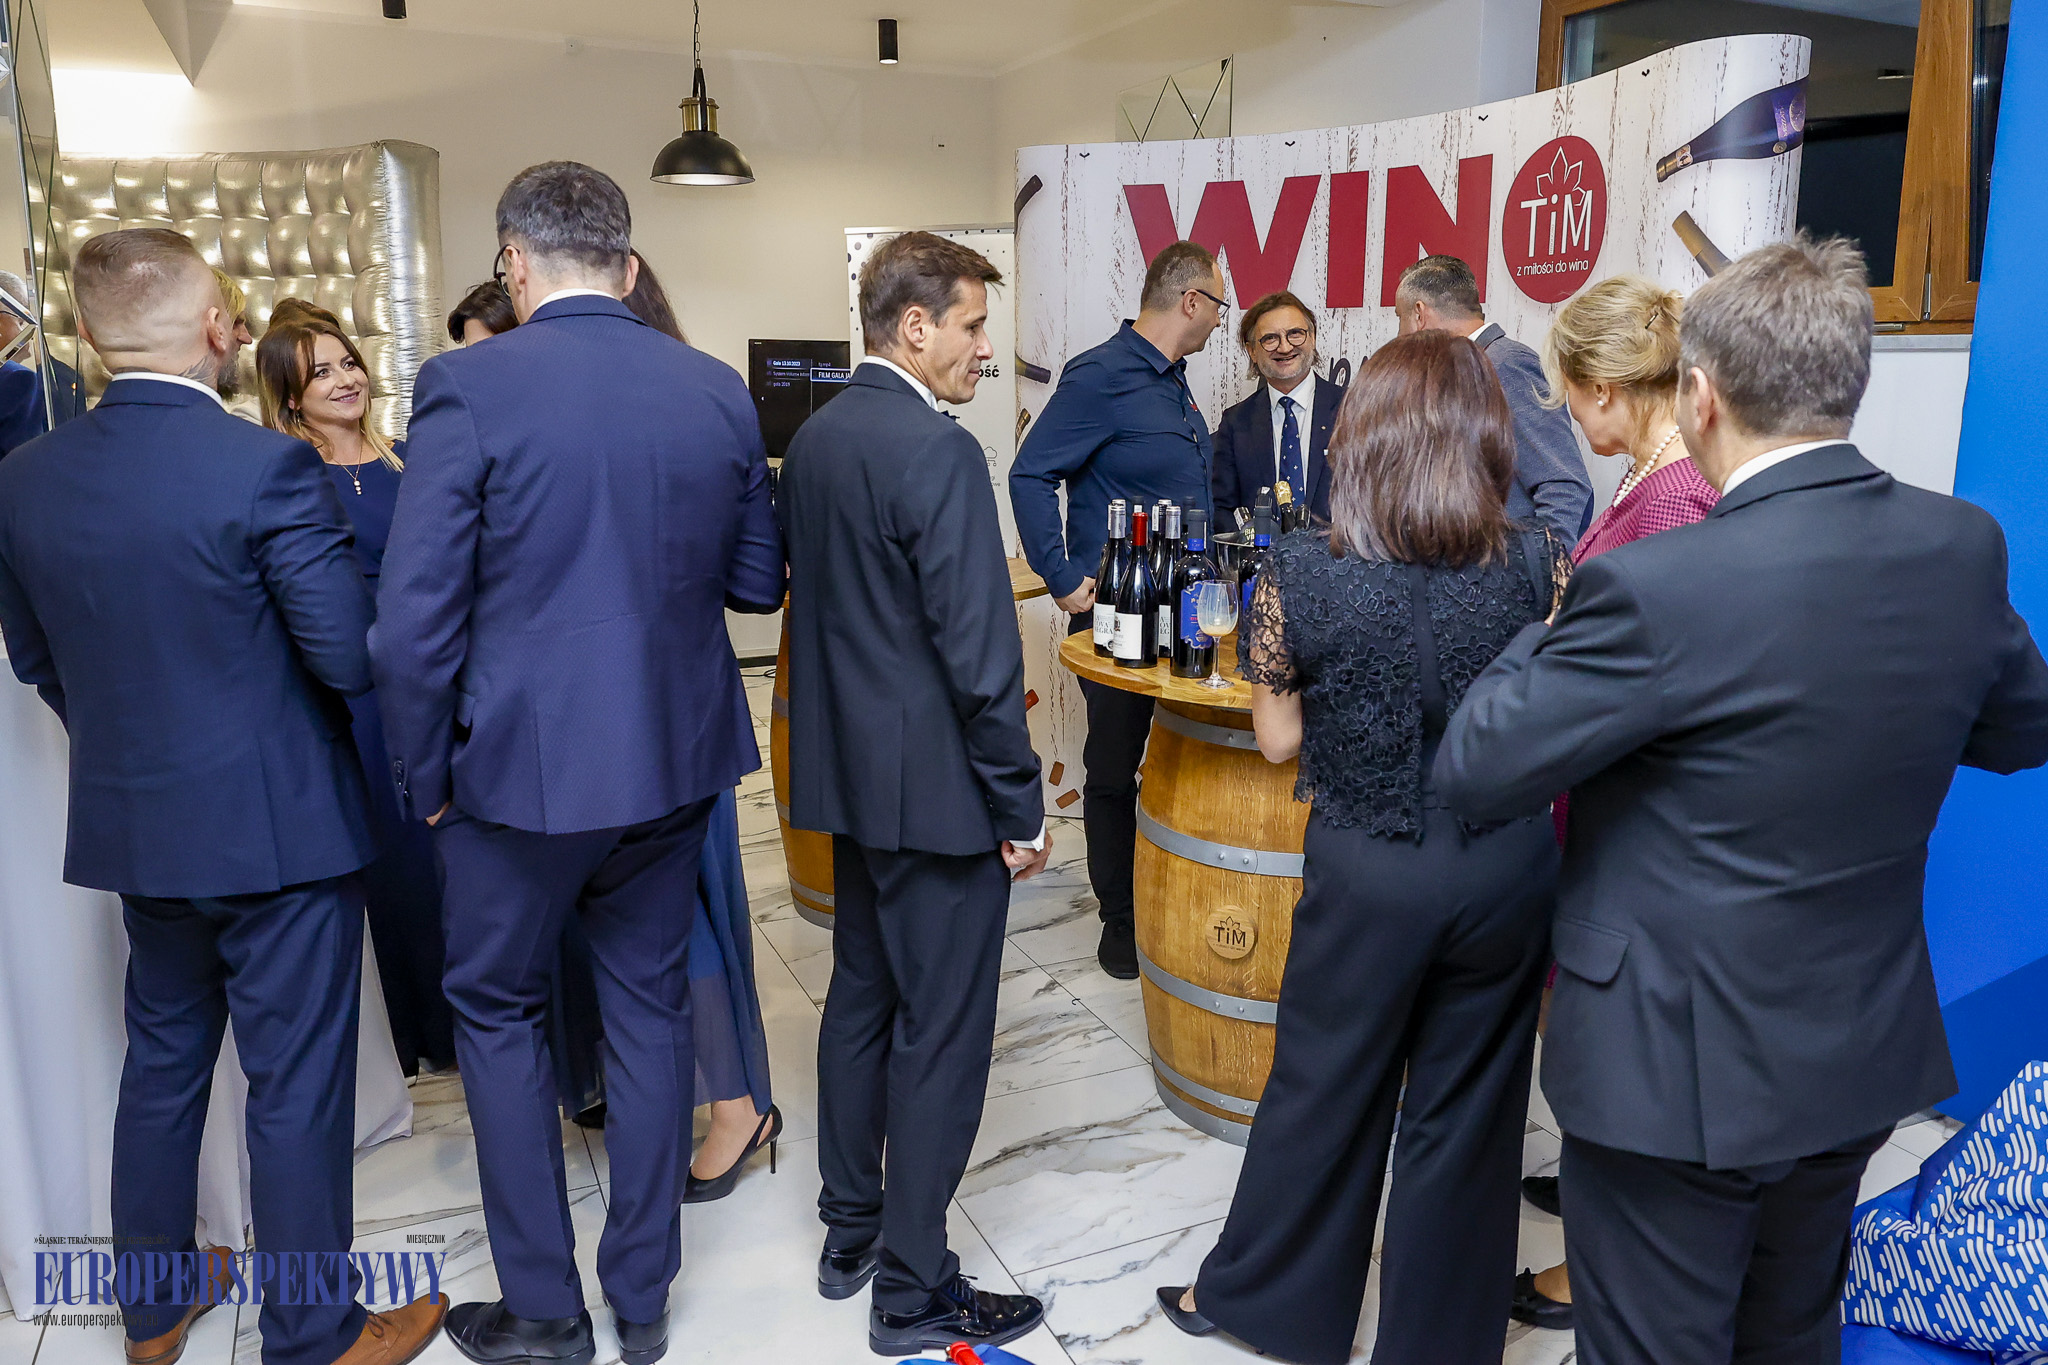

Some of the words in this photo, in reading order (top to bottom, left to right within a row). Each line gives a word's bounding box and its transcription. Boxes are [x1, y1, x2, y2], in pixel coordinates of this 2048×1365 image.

[1123, 154, 1493, 310] WIN
[1520, 189, 1593, 258] TiM
[1516, 266, 1522, 277] z
[1523, 260, 1554, 276] miłości
[1555, 259, 1567, 273] do
[1568, 258, 1589, 272] wina
[1213, 925, 1246, 948] TiM
